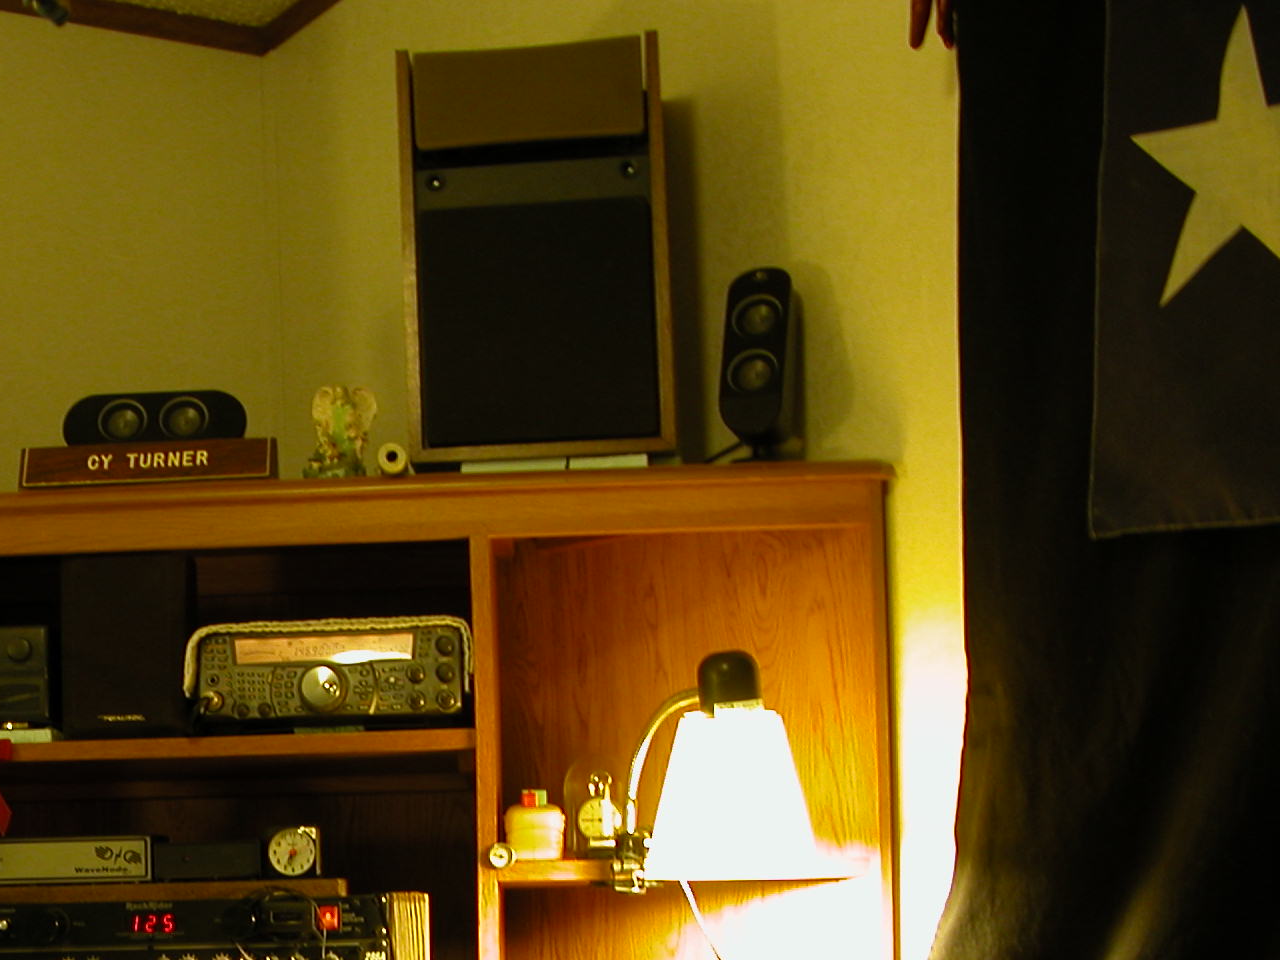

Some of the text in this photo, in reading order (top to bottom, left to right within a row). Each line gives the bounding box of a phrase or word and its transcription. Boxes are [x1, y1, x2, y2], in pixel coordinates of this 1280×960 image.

[87, 450, 208, 470] CY TURNER
[134, 914, 174, 933] 125
